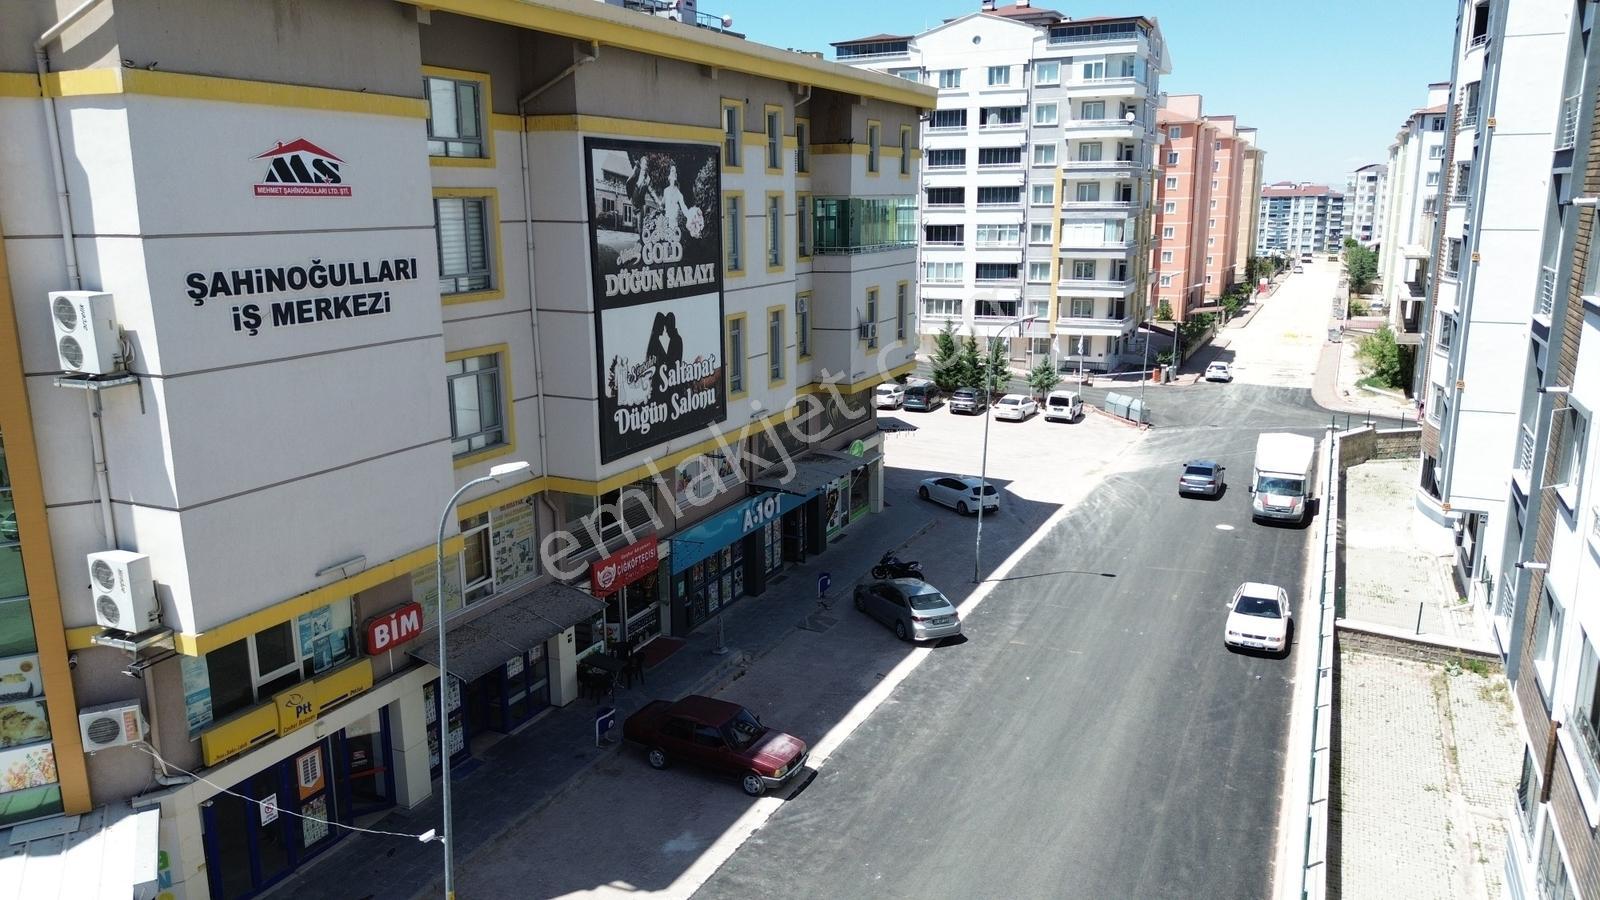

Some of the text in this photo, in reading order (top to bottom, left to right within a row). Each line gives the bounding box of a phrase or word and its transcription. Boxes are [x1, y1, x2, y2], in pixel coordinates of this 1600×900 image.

[257, 186, 282, 194] MEHMET
[642, 241, 683, 265] GOLD
[604, 263, 716, 297] DÜĞÜN SARAYI
[659, 354, 716, 393] Saltanat
[614, 387, 716, 435] Düğün Salonu
[374, 612, 419, 649] BİM
